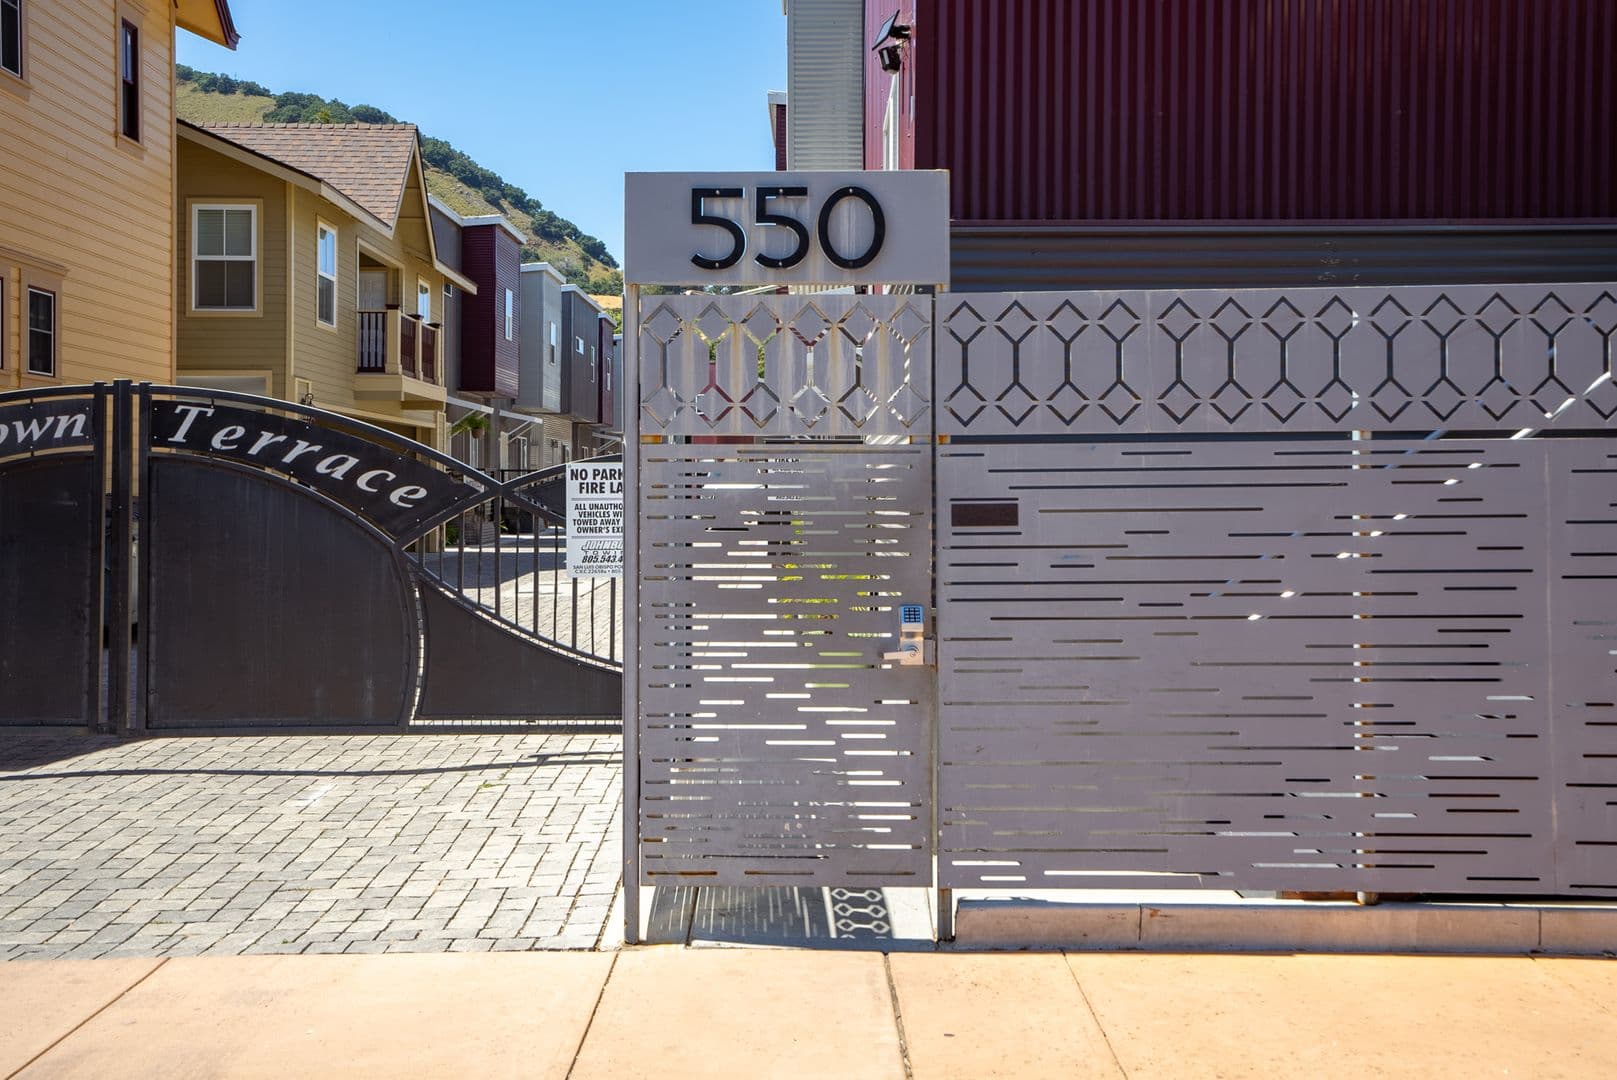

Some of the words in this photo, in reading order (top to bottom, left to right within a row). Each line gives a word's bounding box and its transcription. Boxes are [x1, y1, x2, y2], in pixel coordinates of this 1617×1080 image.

[690, 186, 886, 270] 550
[168, 404, 429, 508] Terrace
[570, 468, 588, 481] NO
[579, 482, 605, 494] FIRE
[609, 482, 624, 494] LA
[574, 503, 587, 511] ALL
[573, 518, 598, 526] TOWED
[599, 518, 621, 526] AWAY
[577, 526, 610, 534] OWNER'S
